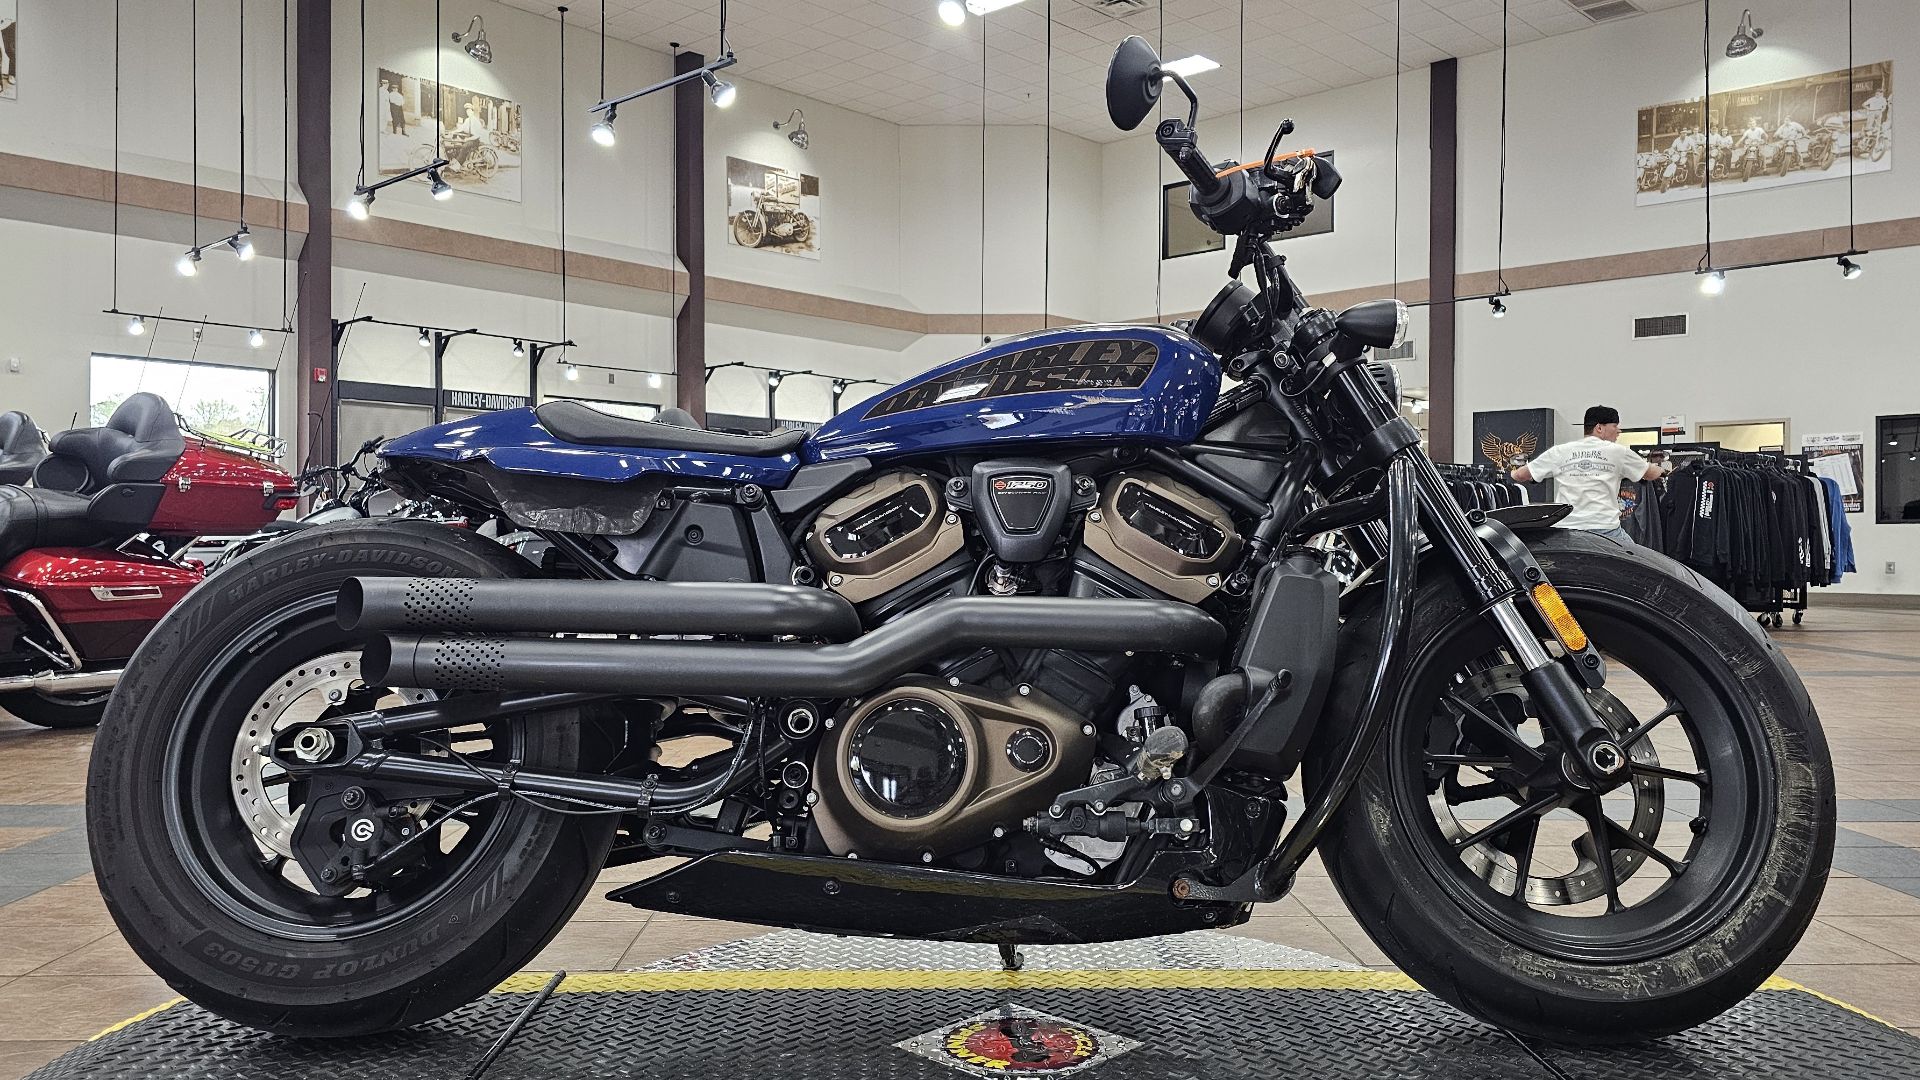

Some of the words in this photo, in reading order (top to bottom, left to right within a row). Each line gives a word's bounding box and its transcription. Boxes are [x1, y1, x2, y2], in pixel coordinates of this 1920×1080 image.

[1007, 481, 1048, 490] 1250
[203, 942, 300, 980] GT503
[312, 923, 441, 980] DUNLOP
